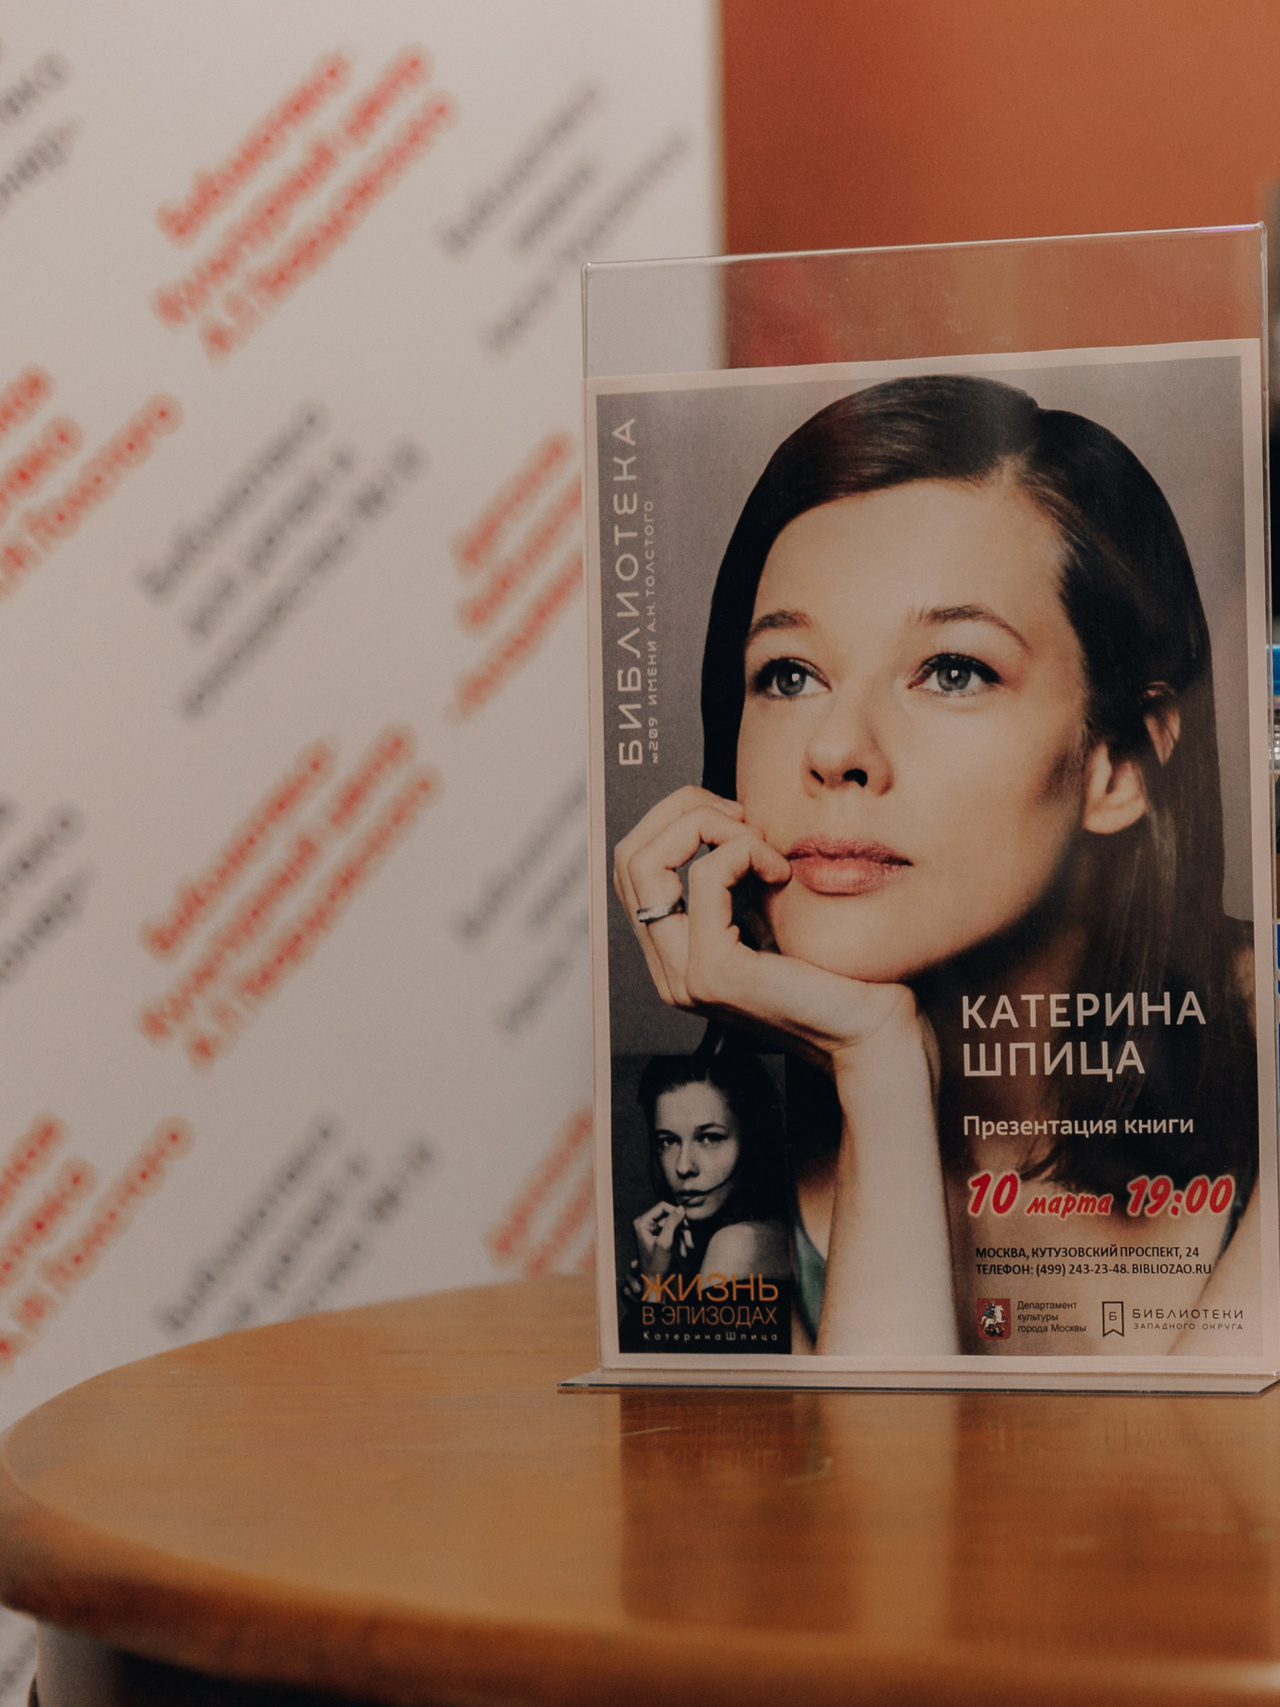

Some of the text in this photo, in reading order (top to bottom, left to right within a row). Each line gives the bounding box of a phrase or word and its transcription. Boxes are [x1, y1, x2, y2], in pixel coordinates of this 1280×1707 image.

[612, 418, 643, 766] БИБЛИОТЕКА
[647, 641, 659, 705] ИМЕНИ
[962, 991, 1206, 1029] КАТЕРИНА
[963, 1040, 1146, 1082] ШПИЦА
[964, 1115, 1194, 1140] Презентация книги
[968, 1170, 1234, 1219] 10 марта 19:00
[976, 1244, 1199, 1260] МОСКВА, КУТУЗОВСКИЙ ПРОСПЕКТ, 24
[976, 1263, 1212, 1277] ТЕЛЕФОН: (499) 243-23-48. BIBLIOZAO.RU
[640, 1273, 779, 1302] ЖИЗНЬ
[642, 1305, 778, 1328] В ЭПИЗОДАХ
[1017, 1300, 1077, 1311] Департамент
[1132, 1308, 1244, 1320] БИБЛИОТЕКИ
[1017, 1314, 1059, 1323] культуры
[1017, 1323, 1087, 1334] города Москвы
[1133, 1322, 1244, 1331] ЗАПАДНОГО ОКРУГА
